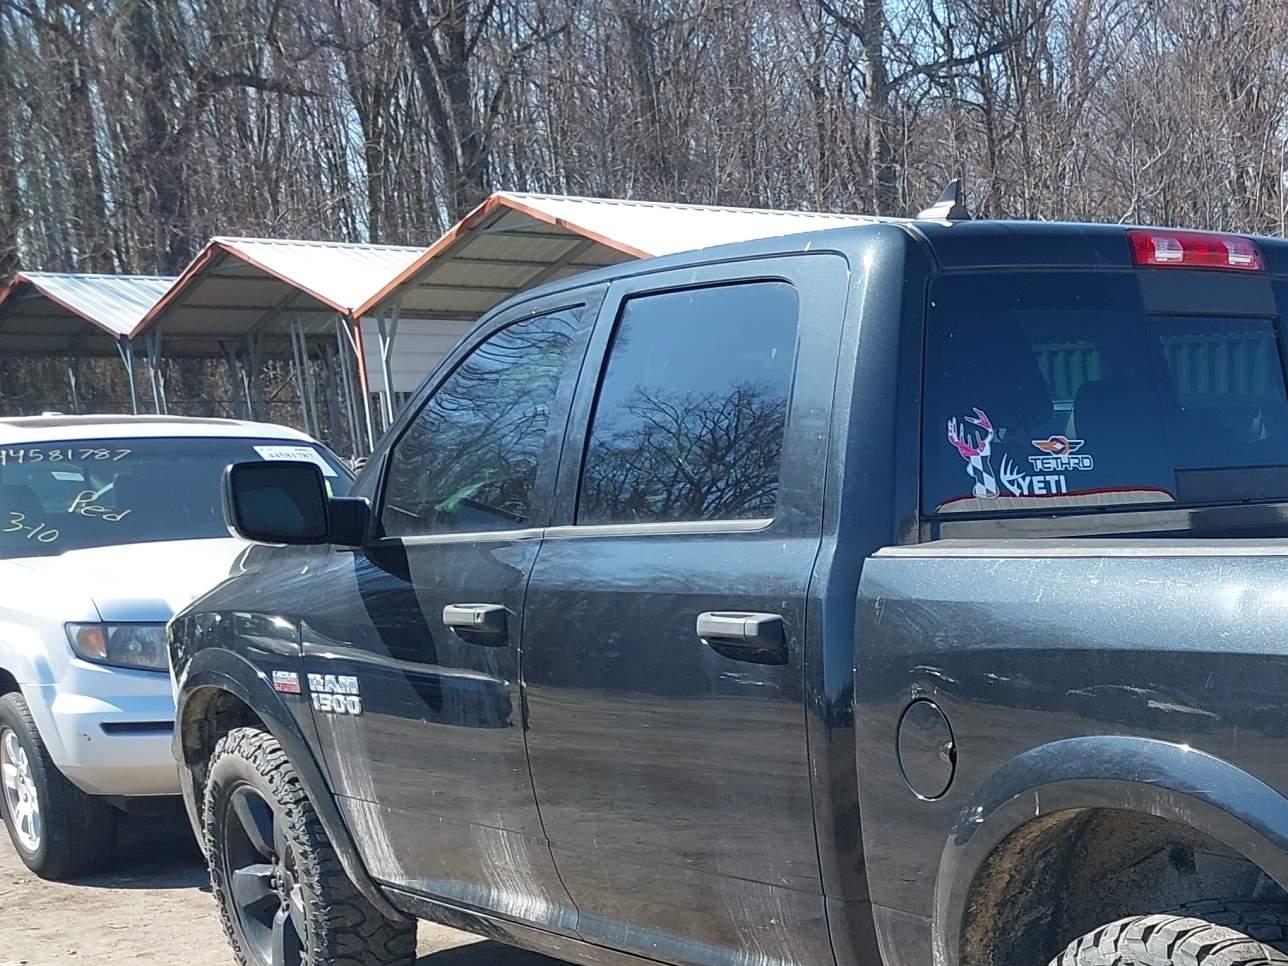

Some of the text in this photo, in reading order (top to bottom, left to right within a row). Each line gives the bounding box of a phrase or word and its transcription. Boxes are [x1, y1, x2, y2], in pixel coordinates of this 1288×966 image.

[1018, 475, 1067, 496] YETI
[2, 512, 60, 543] 3-10
[307, 673, 360, 695] RAM
[311, 693, 363, 715] 1500
